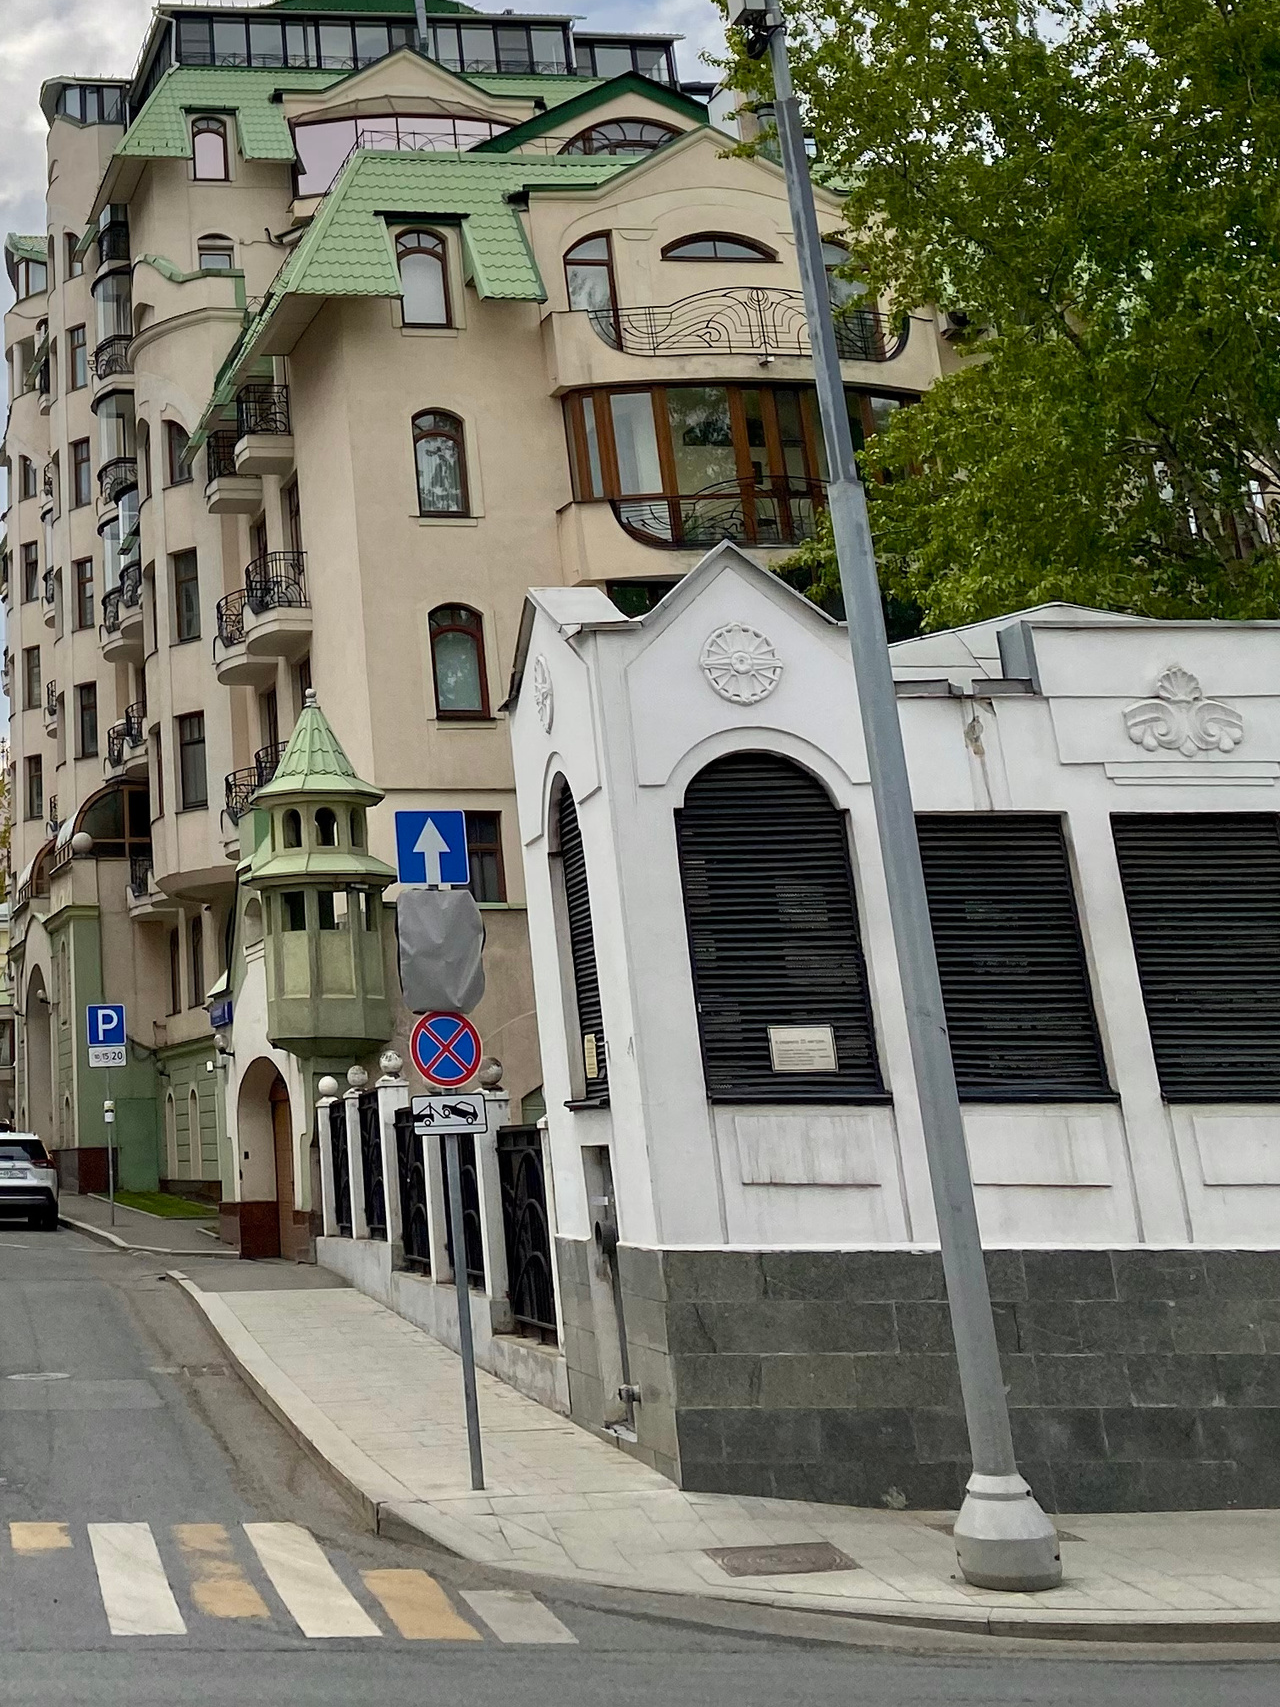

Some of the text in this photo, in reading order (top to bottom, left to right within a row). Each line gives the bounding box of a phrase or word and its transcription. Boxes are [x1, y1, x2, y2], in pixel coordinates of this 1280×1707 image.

[98, 1009, 118, 1041] P
[102, 1052, 109, 1060] 15
[112, 1051, 123, 1060] 20
